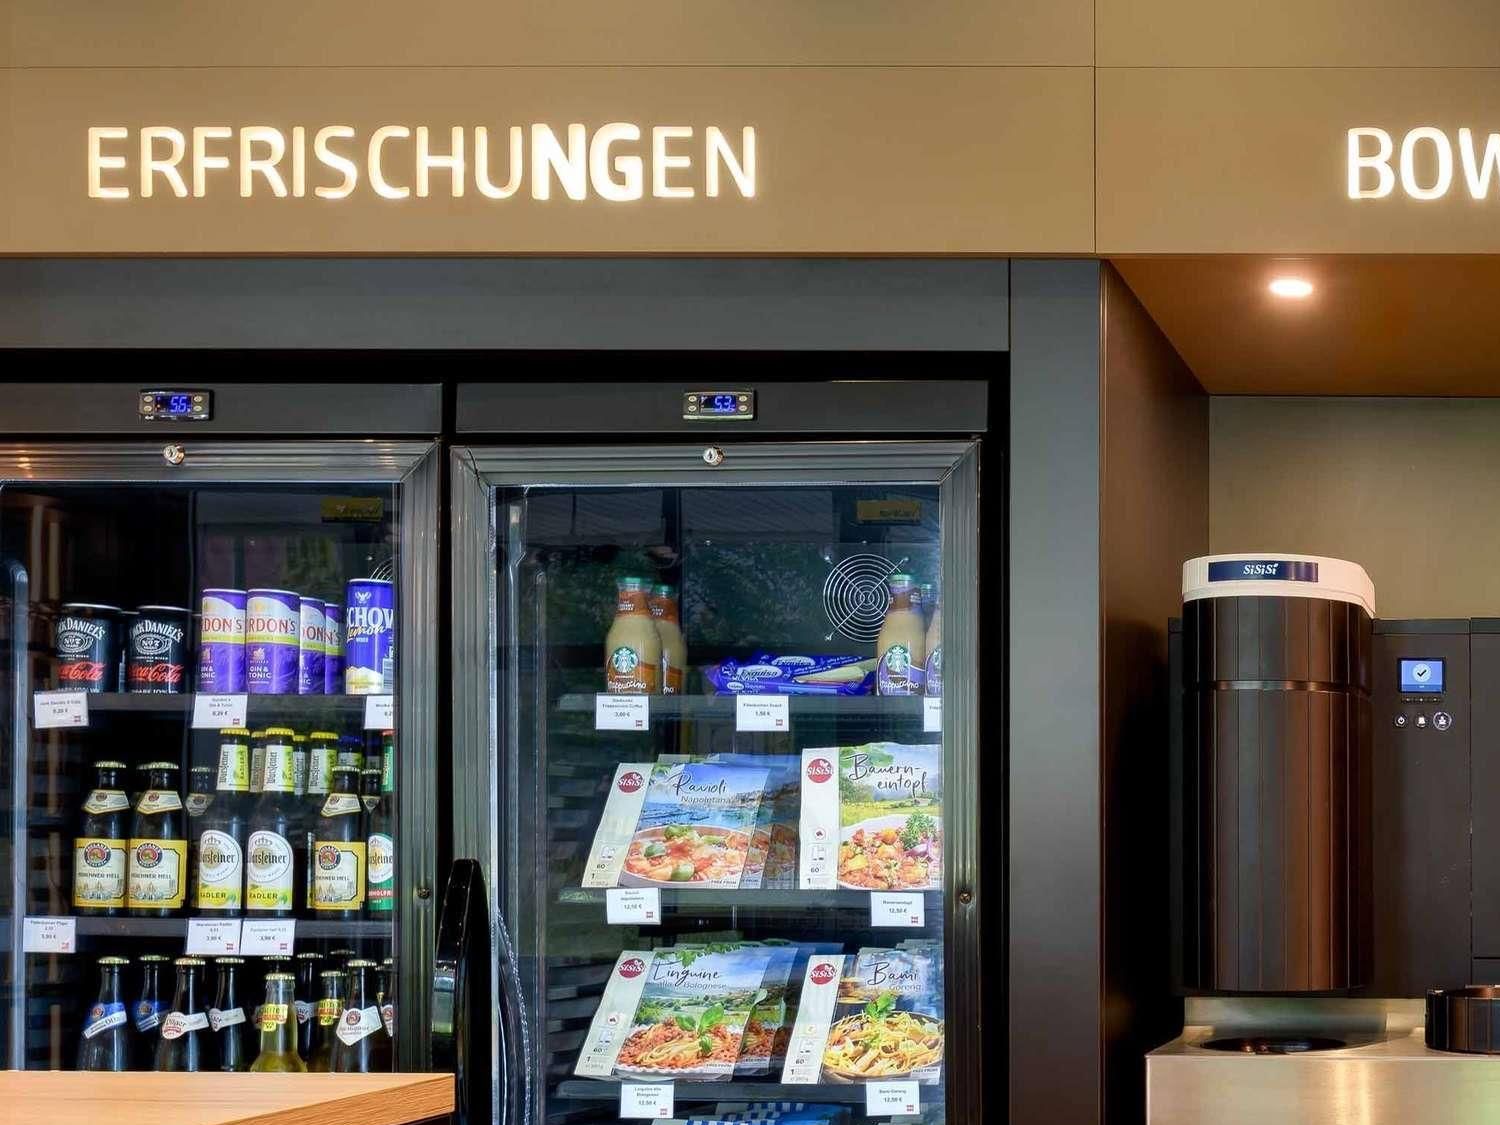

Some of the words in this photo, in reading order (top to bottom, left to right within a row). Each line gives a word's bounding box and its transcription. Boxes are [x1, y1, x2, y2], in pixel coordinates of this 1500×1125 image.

[87, 123, 755, 201] ERFRISCHUNGEN
[248, 617, 296, 633] RDON'S
[844, 753, 921, 781] Bauern-
[664, 772, 727, 796] Ravioli
[201, 852, 235, 869] rsteiner
[649, 960, 720, 986] Linguine
[862, 961, 918, 986] Bami
